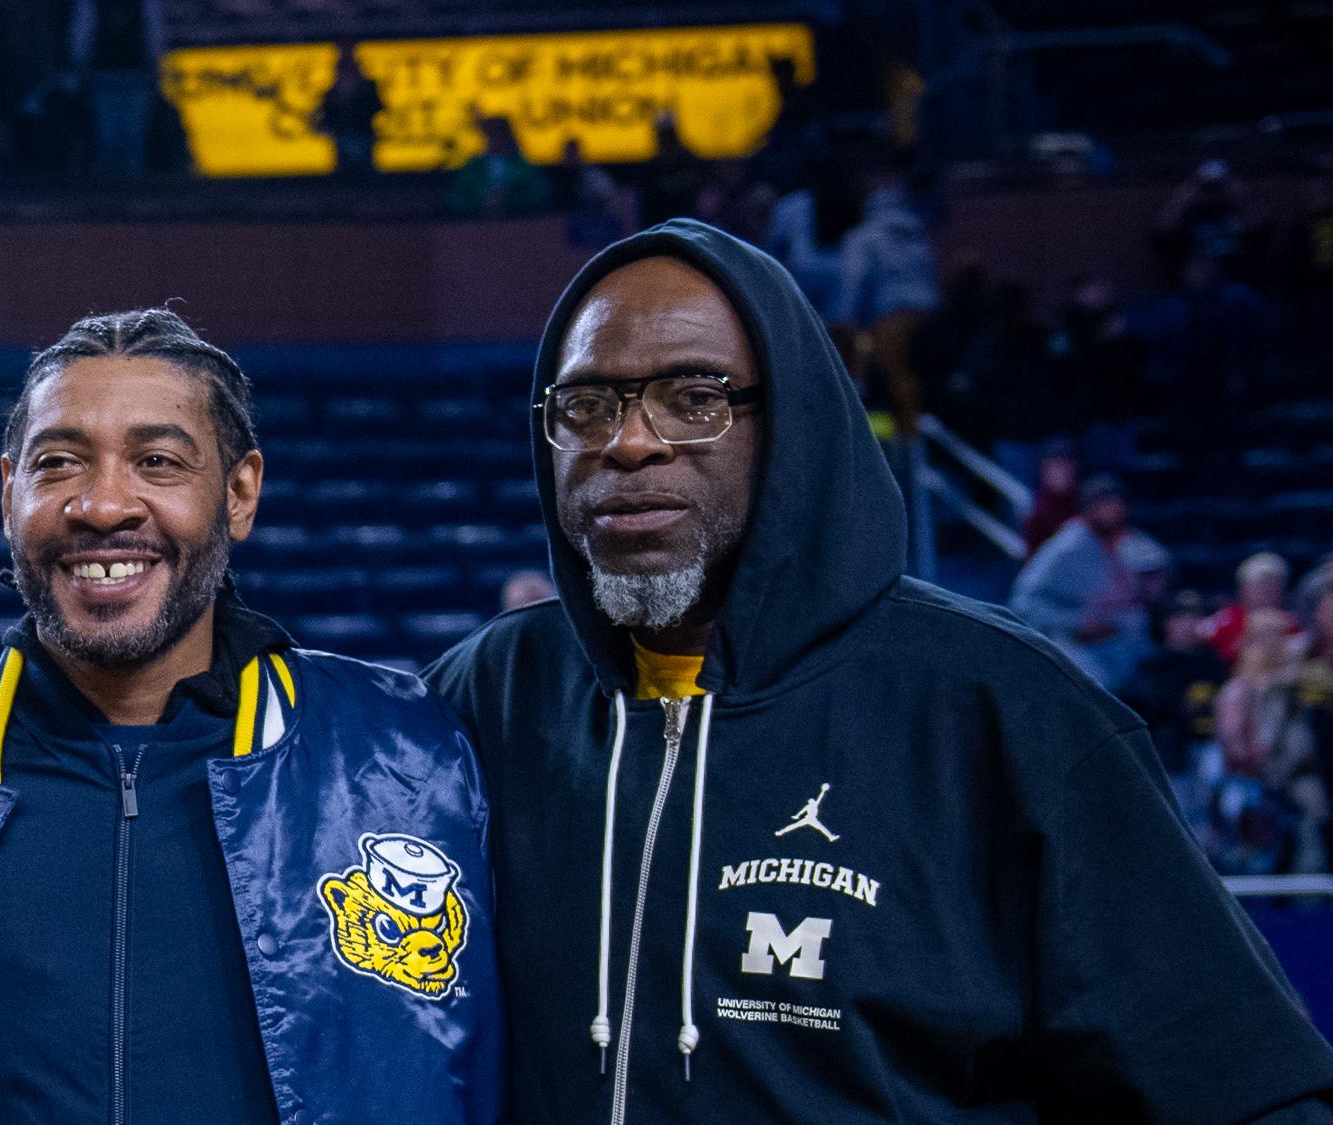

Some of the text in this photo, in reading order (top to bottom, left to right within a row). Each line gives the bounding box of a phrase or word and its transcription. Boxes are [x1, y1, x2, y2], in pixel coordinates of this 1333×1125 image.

[382, 868, 427, 908] M
[718, 858, 881, 907] MICHIGAN
[741, 911, 833, 980] M
[717, 1008, 840, 1030] WOLVERINE BASKETBALL
[718, 997, 841, 1019] UNIVERSITY OF MICHIGAN
